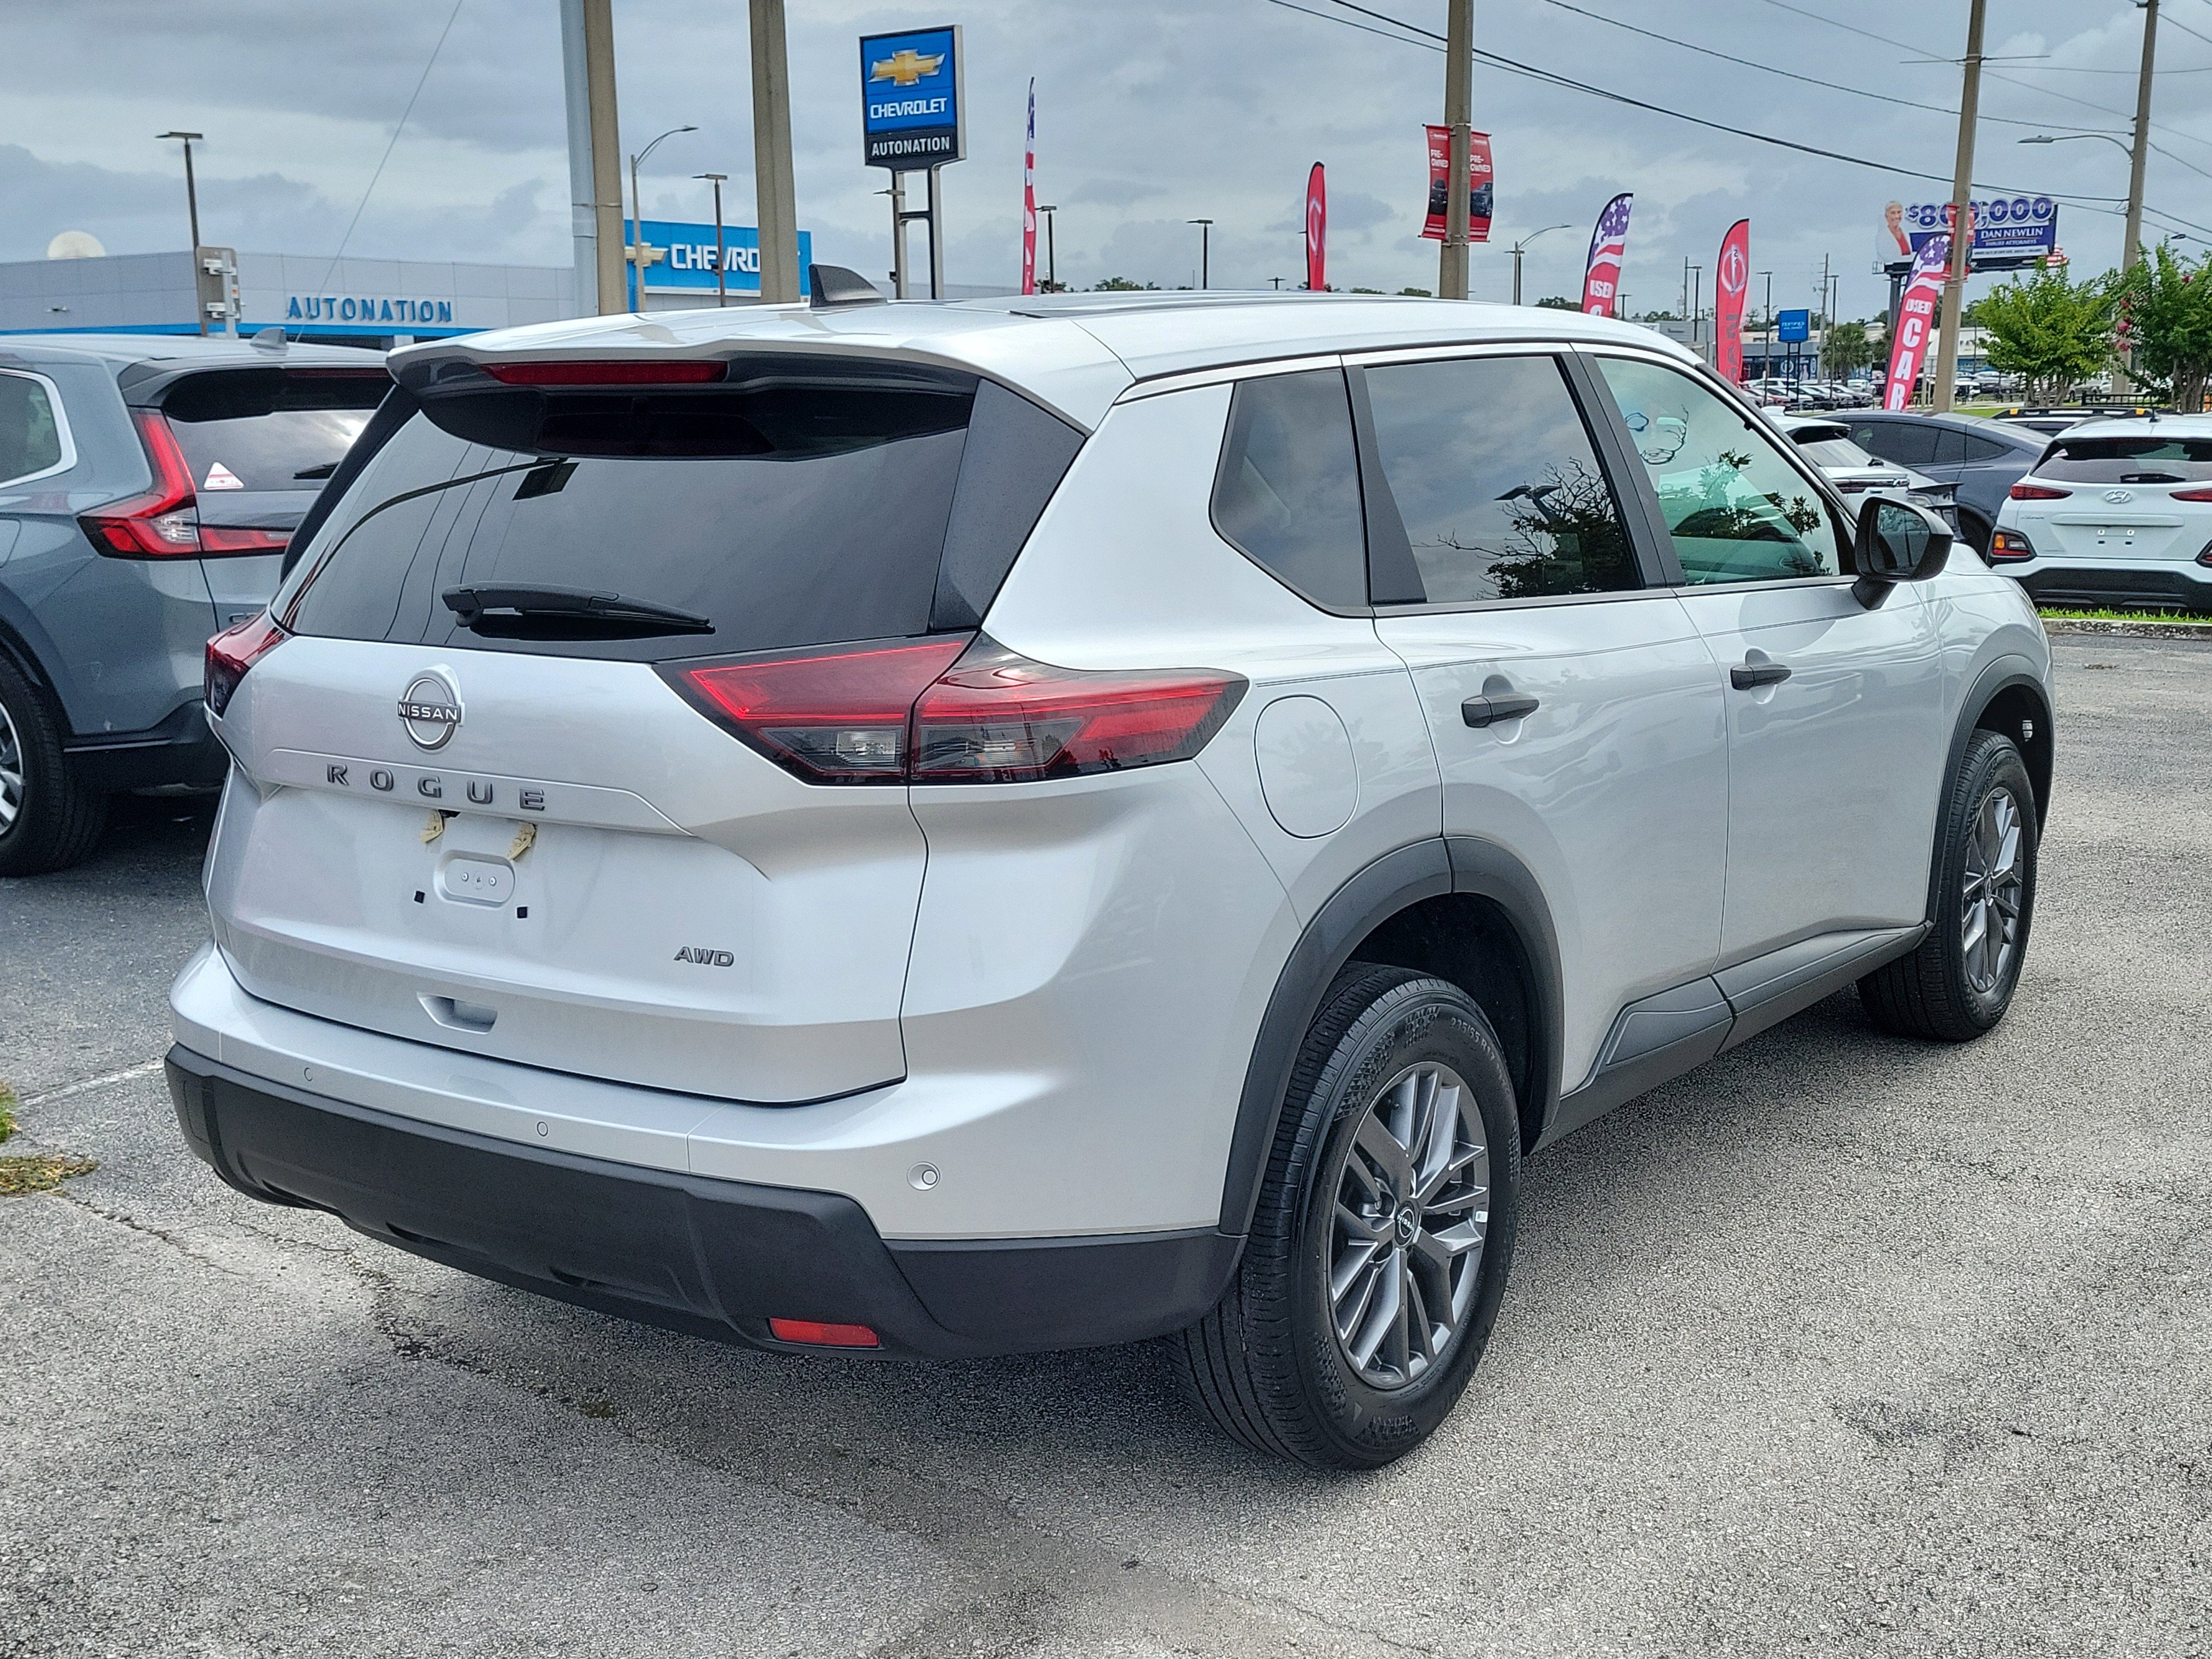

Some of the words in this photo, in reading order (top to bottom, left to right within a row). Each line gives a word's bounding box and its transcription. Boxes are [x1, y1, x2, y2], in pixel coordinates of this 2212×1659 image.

[870, 98, 947, 119] CHEVROLET
[871, 137, 950, 156] AUTONATION
[1980, 229, 2002, 239] DAN
[2003, 227, 2044, 238] NEWLIN
[670, 244, 760, 272] CHEVRO
[286, 297, 452, 323] AUTONATION
[398, 703, 458, 720] NISSAN
[326, 763, 545, 811] ROGUE
[673, 946, 735, 967] AWD
